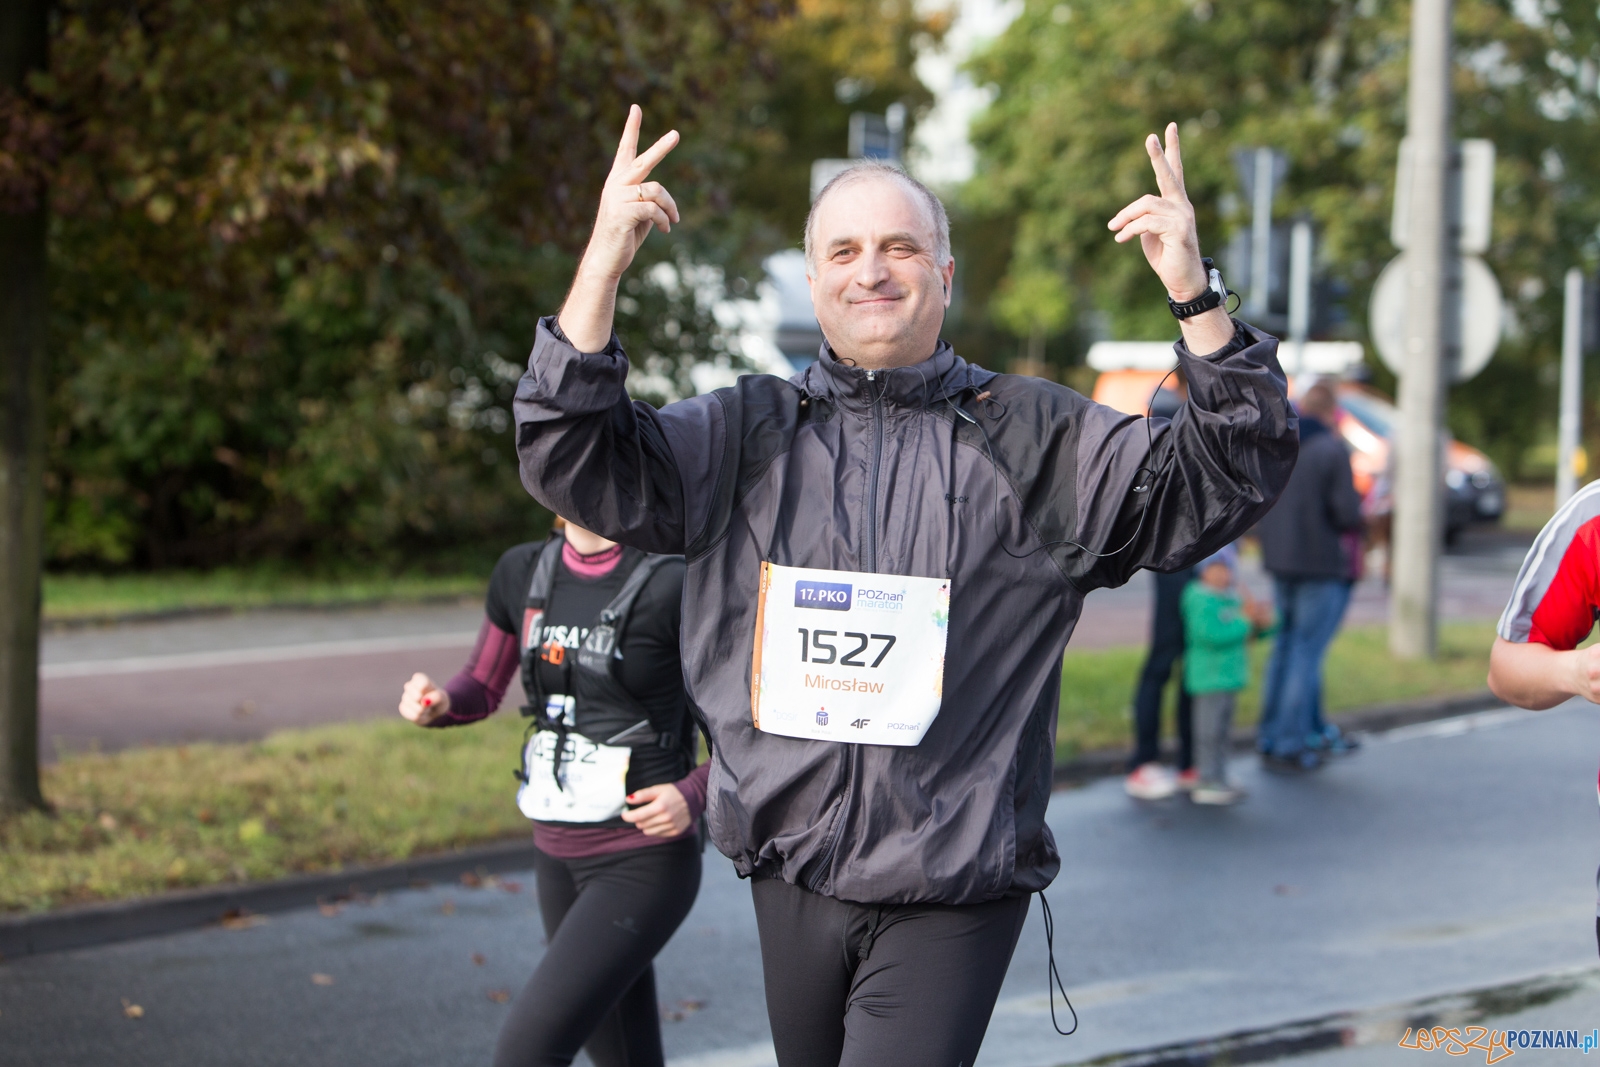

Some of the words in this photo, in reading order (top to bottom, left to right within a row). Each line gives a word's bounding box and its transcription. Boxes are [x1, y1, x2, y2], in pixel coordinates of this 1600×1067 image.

[818, 589, 848, 604] PKO
[856, 599, 903, 610] maraton
[798, 627, 897, 669] 1527
[804, 673, 885, 694] Mirosław
[850, 718, 871, 729] 4F
